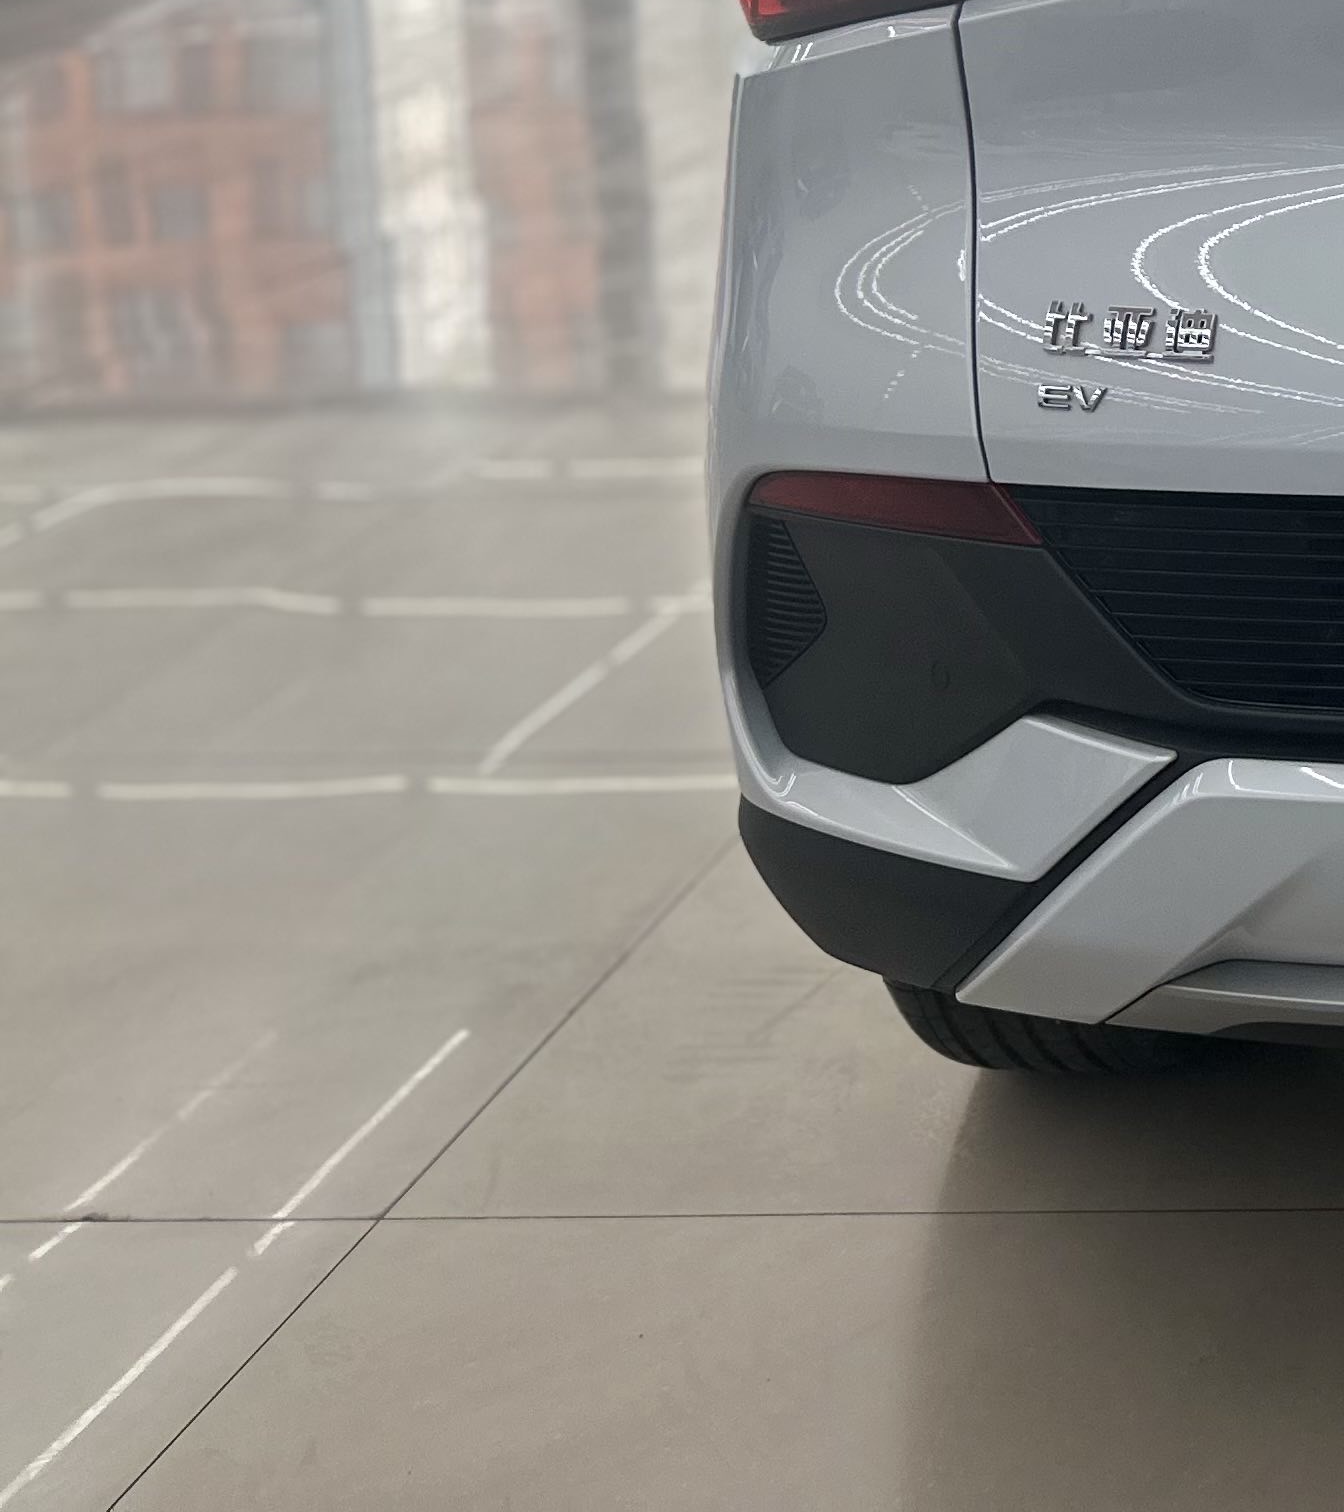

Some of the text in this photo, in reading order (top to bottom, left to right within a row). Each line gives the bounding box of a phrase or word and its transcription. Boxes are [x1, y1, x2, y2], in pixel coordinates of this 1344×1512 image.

[1043, 300, 1219, 364] 比亚迪
[1037, 384, 1108, 413] EV
